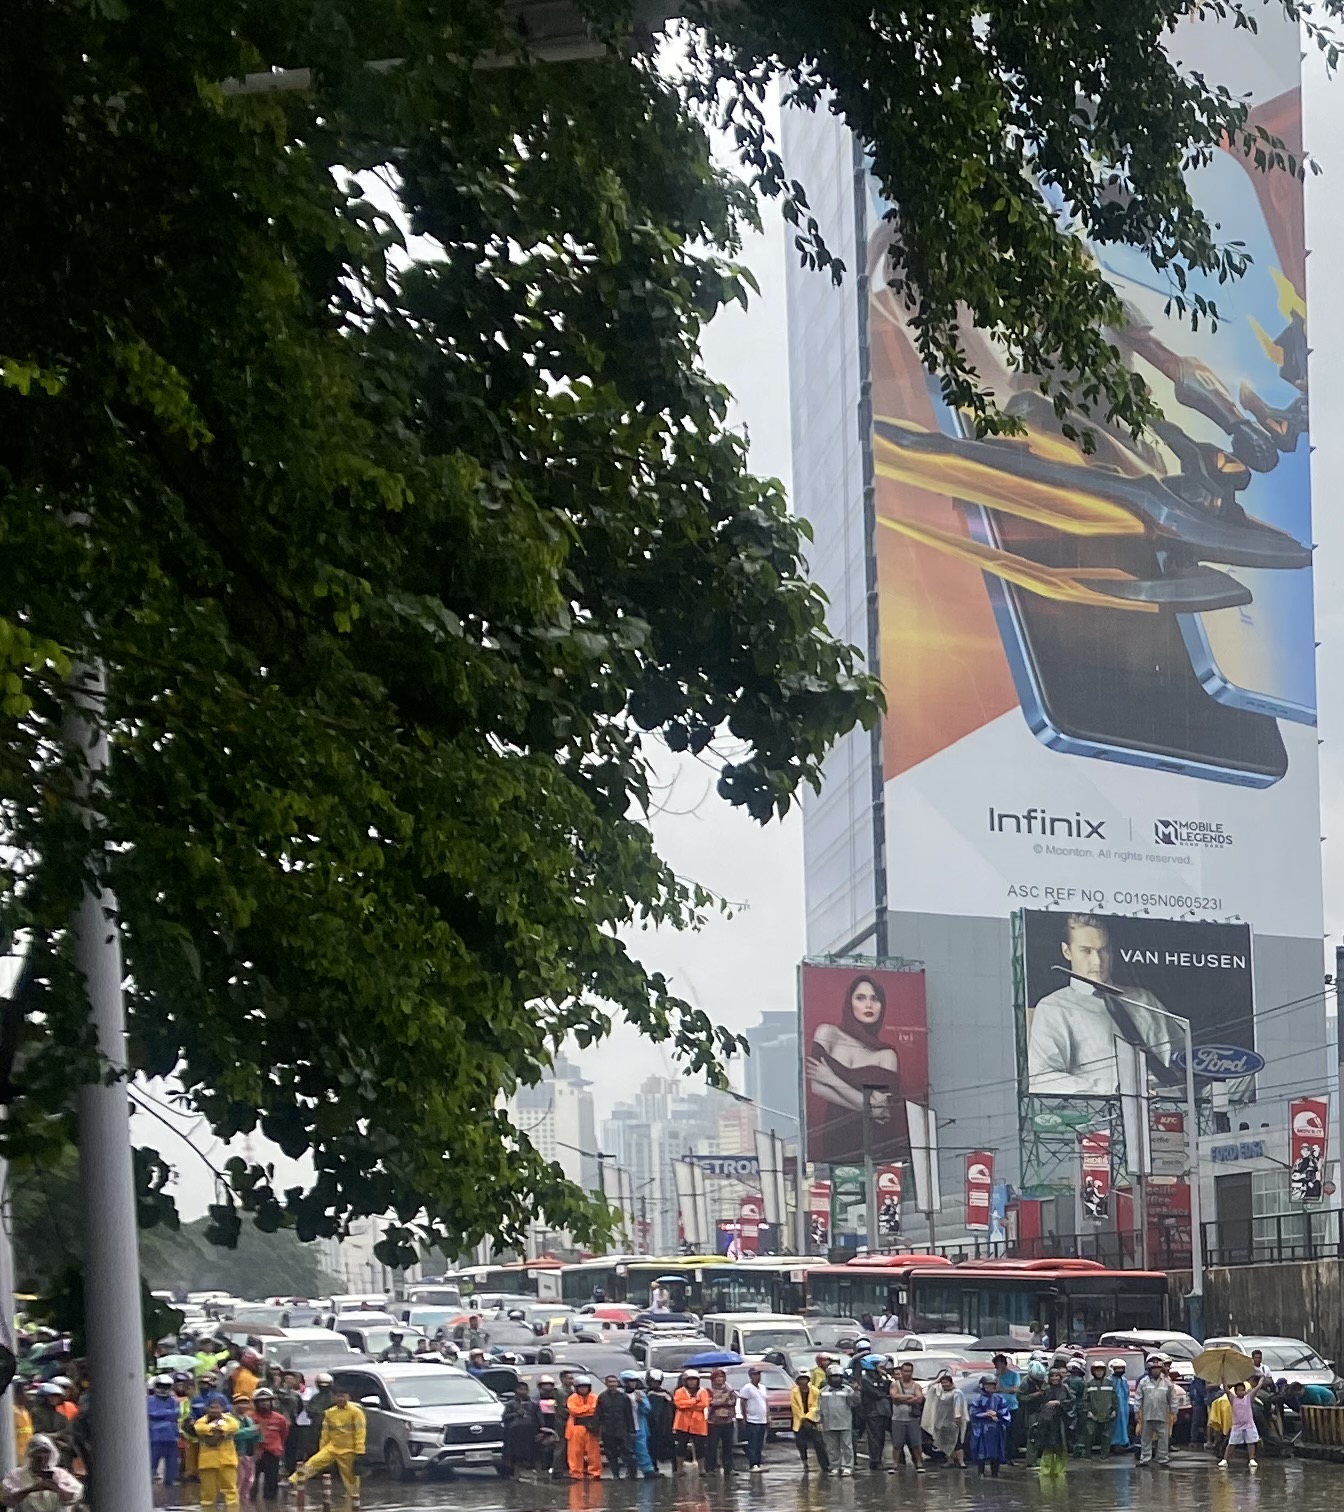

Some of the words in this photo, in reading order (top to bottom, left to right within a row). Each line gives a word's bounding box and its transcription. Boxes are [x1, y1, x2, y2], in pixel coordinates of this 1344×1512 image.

[988, 807, 1106, 840] Infinix
[1179, 820, 1224, 834] MOBILE
[1179, 831, 1233, 845] LEGENDS
[1045, 844, 1095, 858] Moonton.
[1097, 849, 1112, 859] All
[1113, 850, 1143, 863] rights
[1007, 884, 1039, 898] ASC
[1044, 886, 1077, 900] REF
[1120, 948, 1159, 965] VAN
[1165, 951, 1246, 969] HEUSEN
[1193, 1049, 1248, 1073] Ford
[1146, 1195, 1172, 1205] ffice
